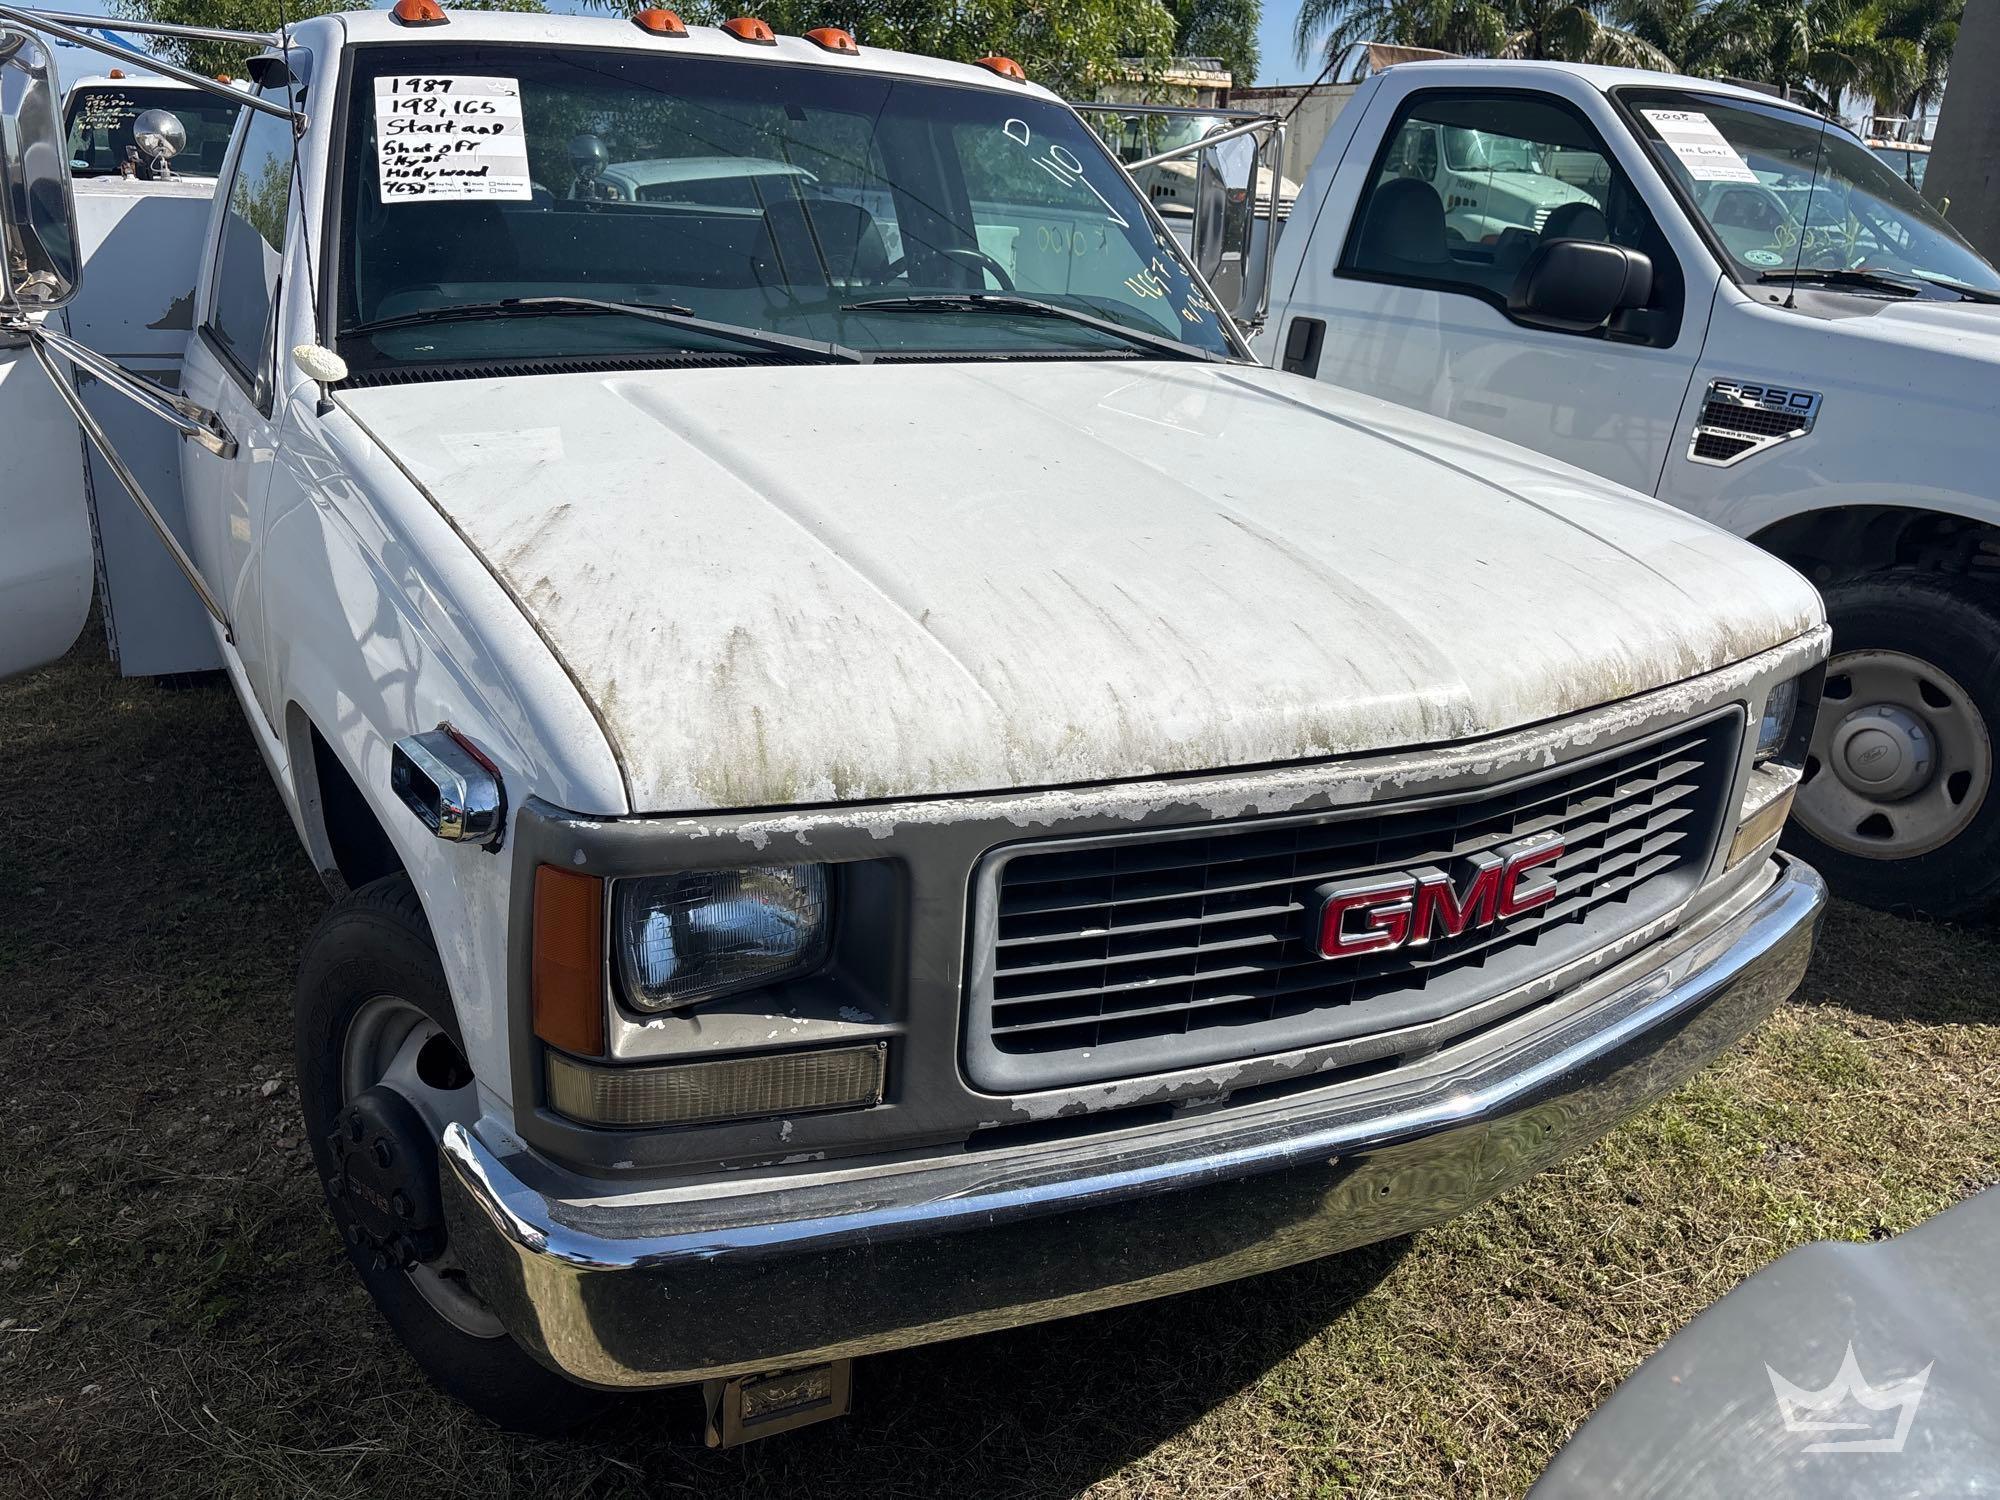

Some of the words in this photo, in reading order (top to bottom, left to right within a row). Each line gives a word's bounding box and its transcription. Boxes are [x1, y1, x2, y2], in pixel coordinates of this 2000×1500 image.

[392, 98, 496, 117] 198,165
[386, 119, 456, 135] Start
[382, 140, 433, 155] Shut
[1712, 381, 1814, 409] F-250
[1784, 407, 1809, 415] DUTY
[1710, 428, 1736, 437] POWER
[1737, 433, 1766, 442] STROKE
[1313, 829, 1566, 960] GMC
